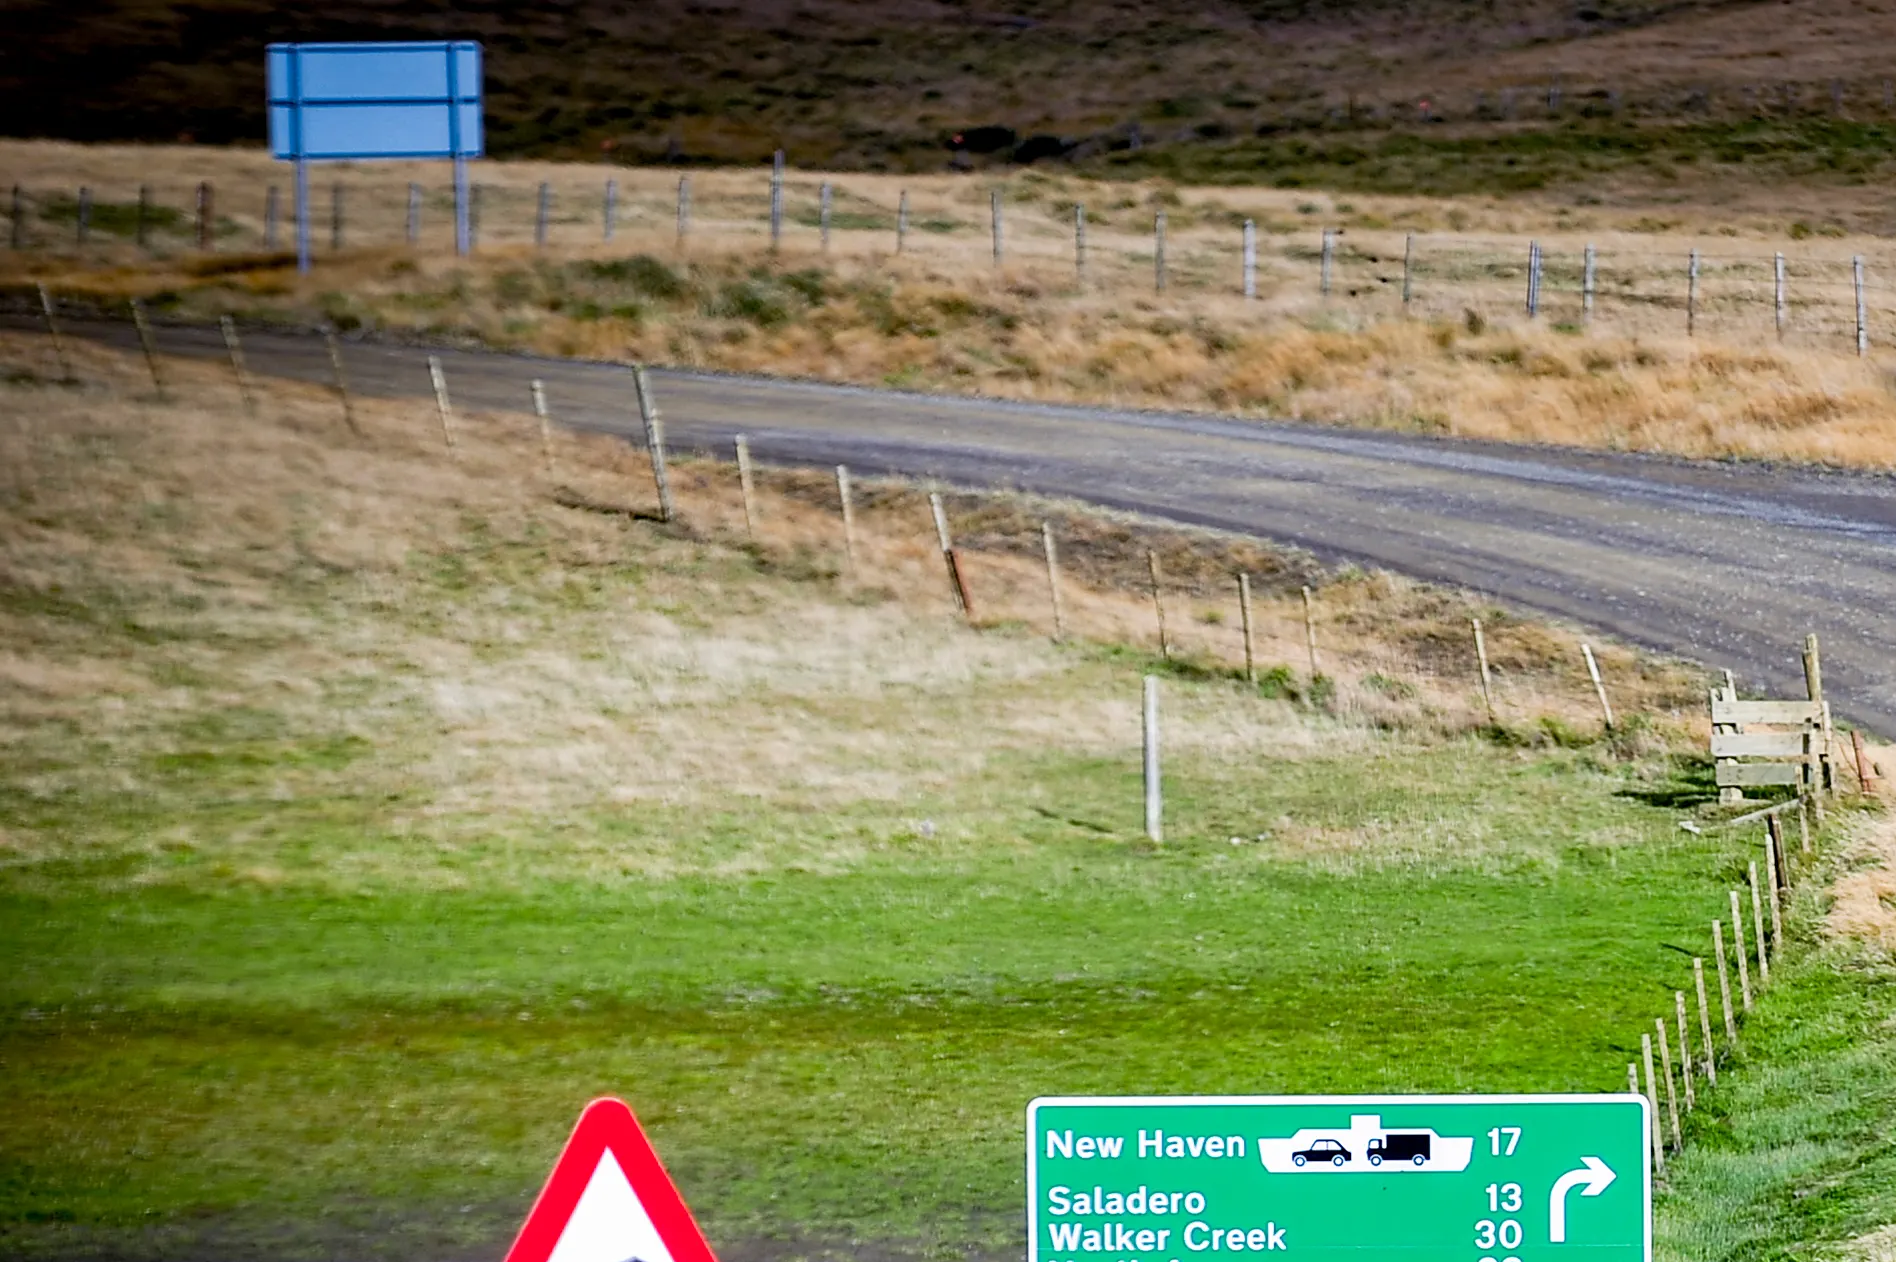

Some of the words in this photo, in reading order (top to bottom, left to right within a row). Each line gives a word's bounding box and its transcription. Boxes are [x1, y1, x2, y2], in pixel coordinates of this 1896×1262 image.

[1046, 1129, 1124, 1159] New
[1138, 1129, 1245, 1158] Haven
[1487, 1127, 1522, 1156] 17
[1048, 1185, 1206, 1216] Saladero
[1485, 1182, 1522, 1212] 13
[1048, 1222, 1171, 1252] Walker
[1183, 1221, 1287, 1251] Creek
[1474, 1219, 1523, 1249] 30
